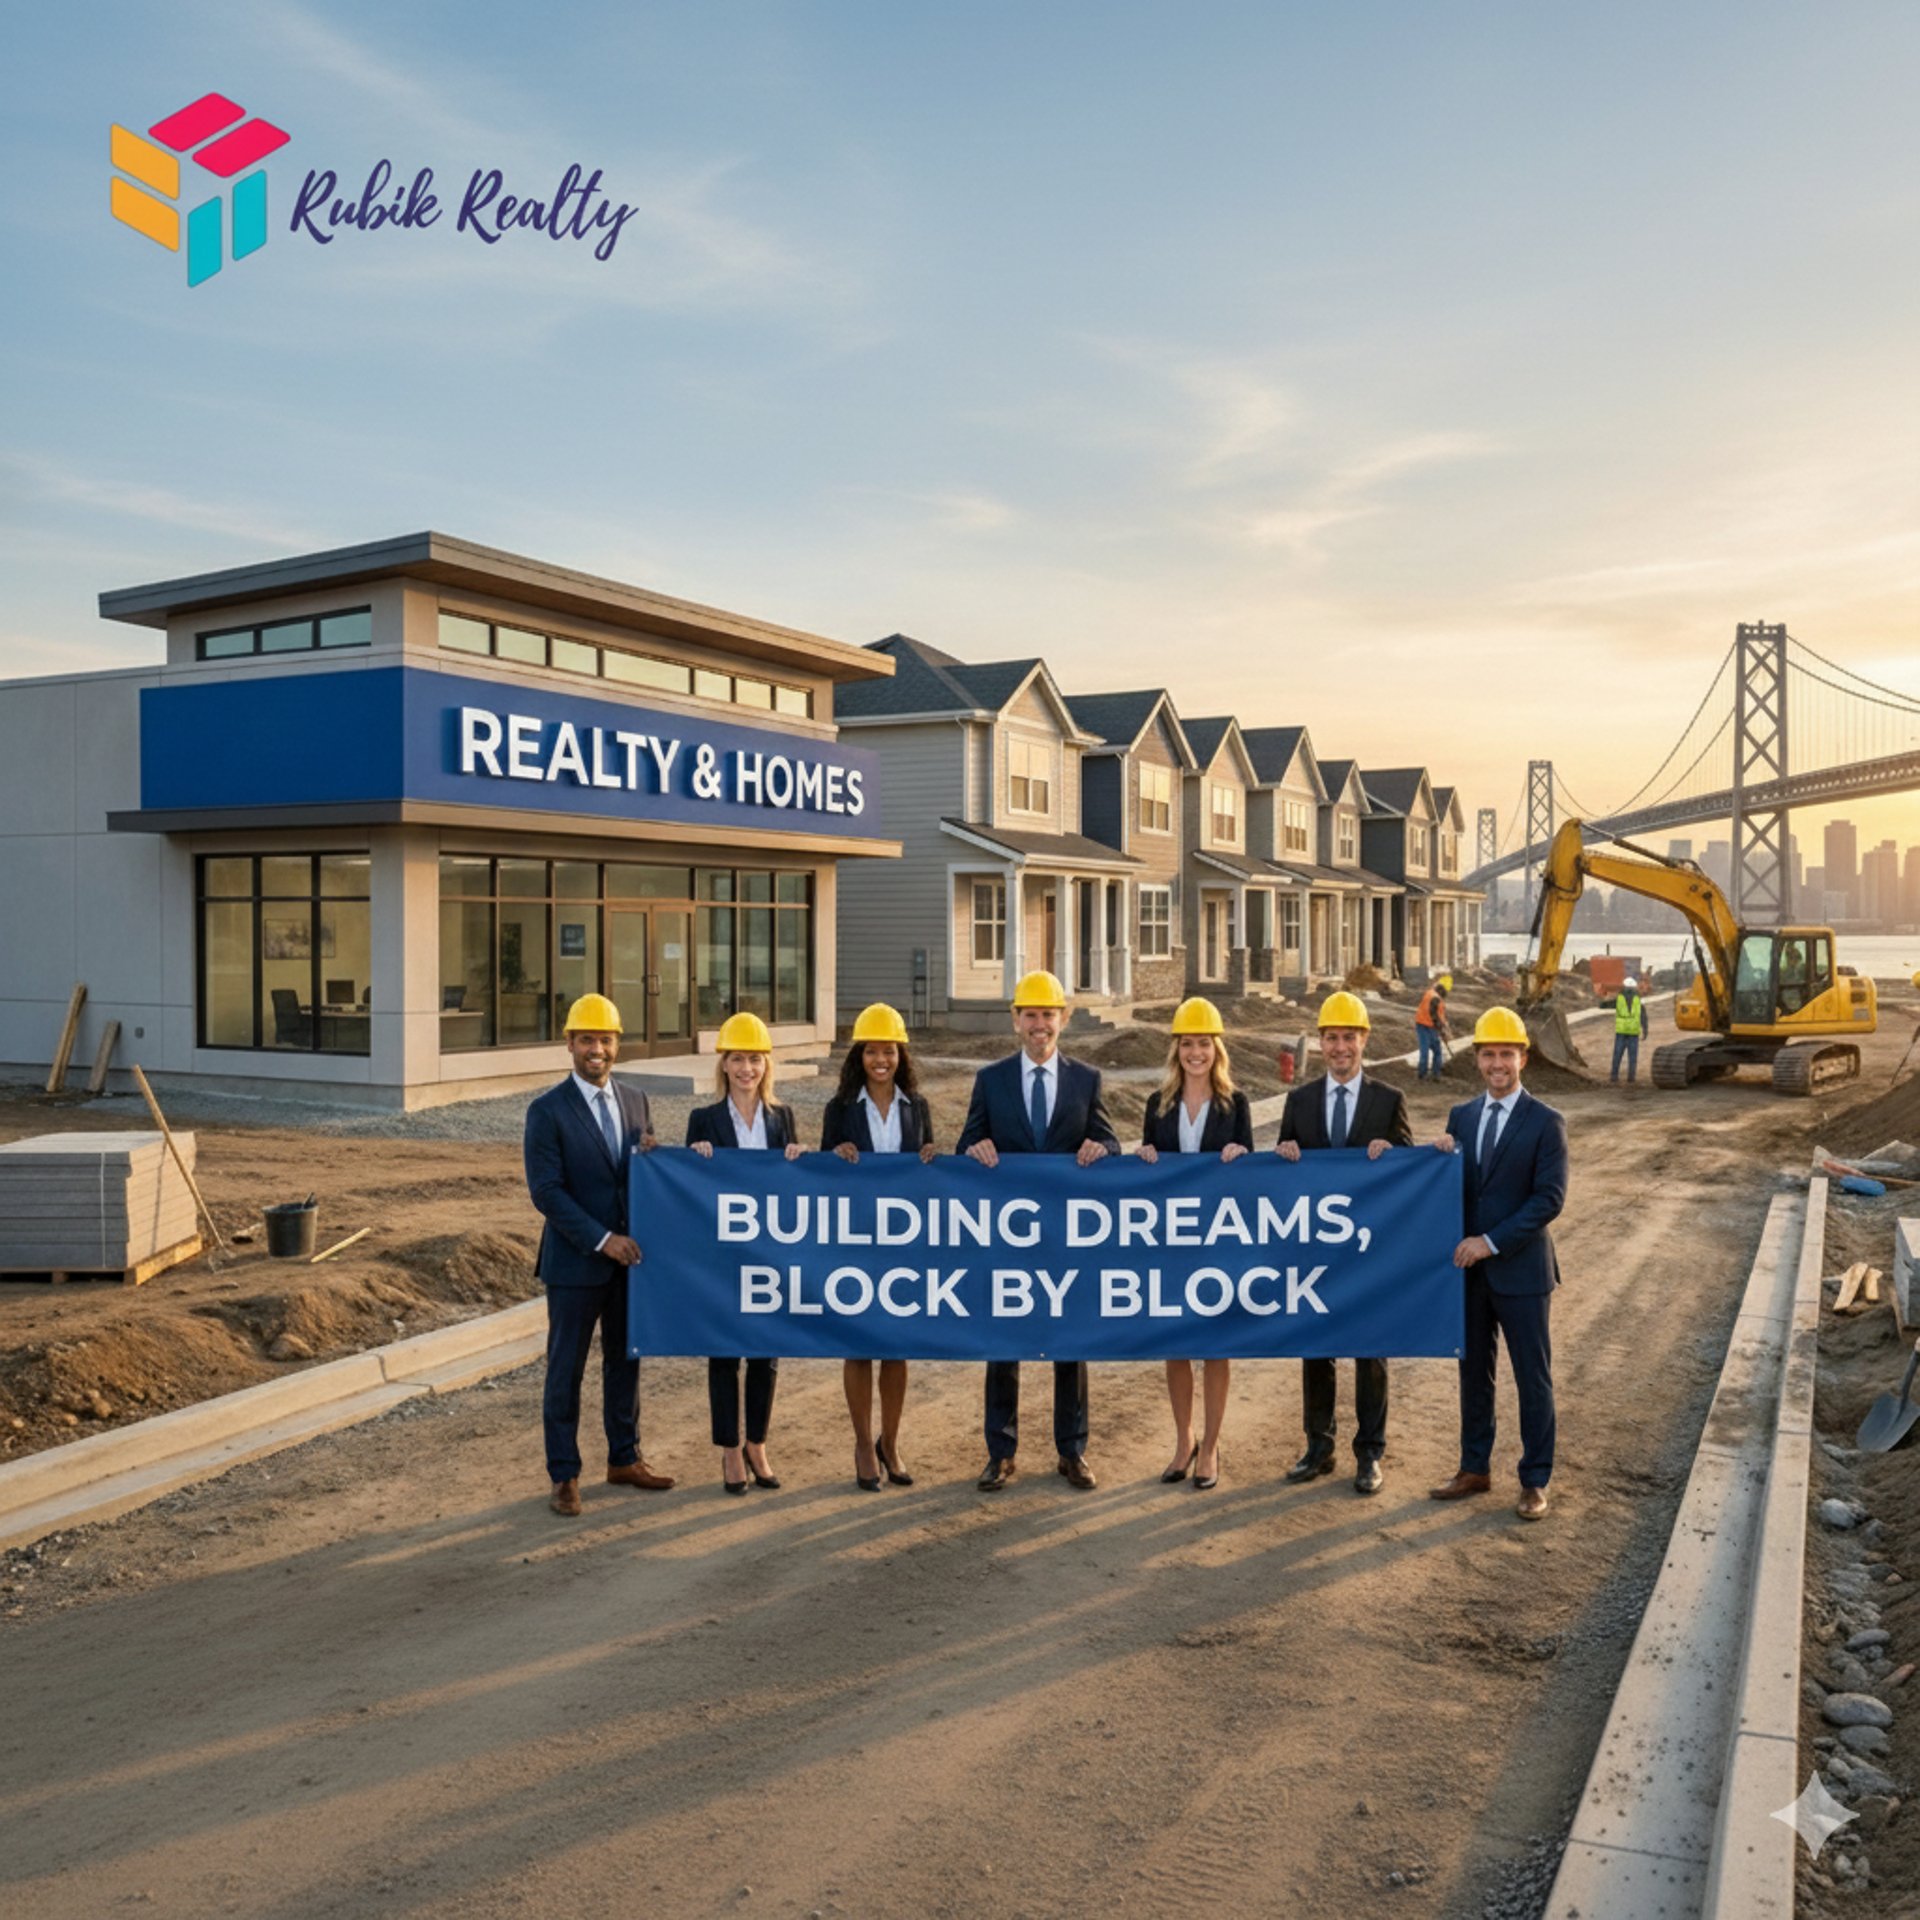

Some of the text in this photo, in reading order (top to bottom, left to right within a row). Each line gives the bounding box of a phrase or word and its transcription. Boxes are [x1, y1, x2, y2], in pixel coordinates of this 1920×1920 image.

[460, 705, 867, 816] REALTY & HOMES
[717, 1193, 1373, 1253] BUILDING DREAMS,
[739, 1265, 1330, 1318] BLOCK BY BLOCK
